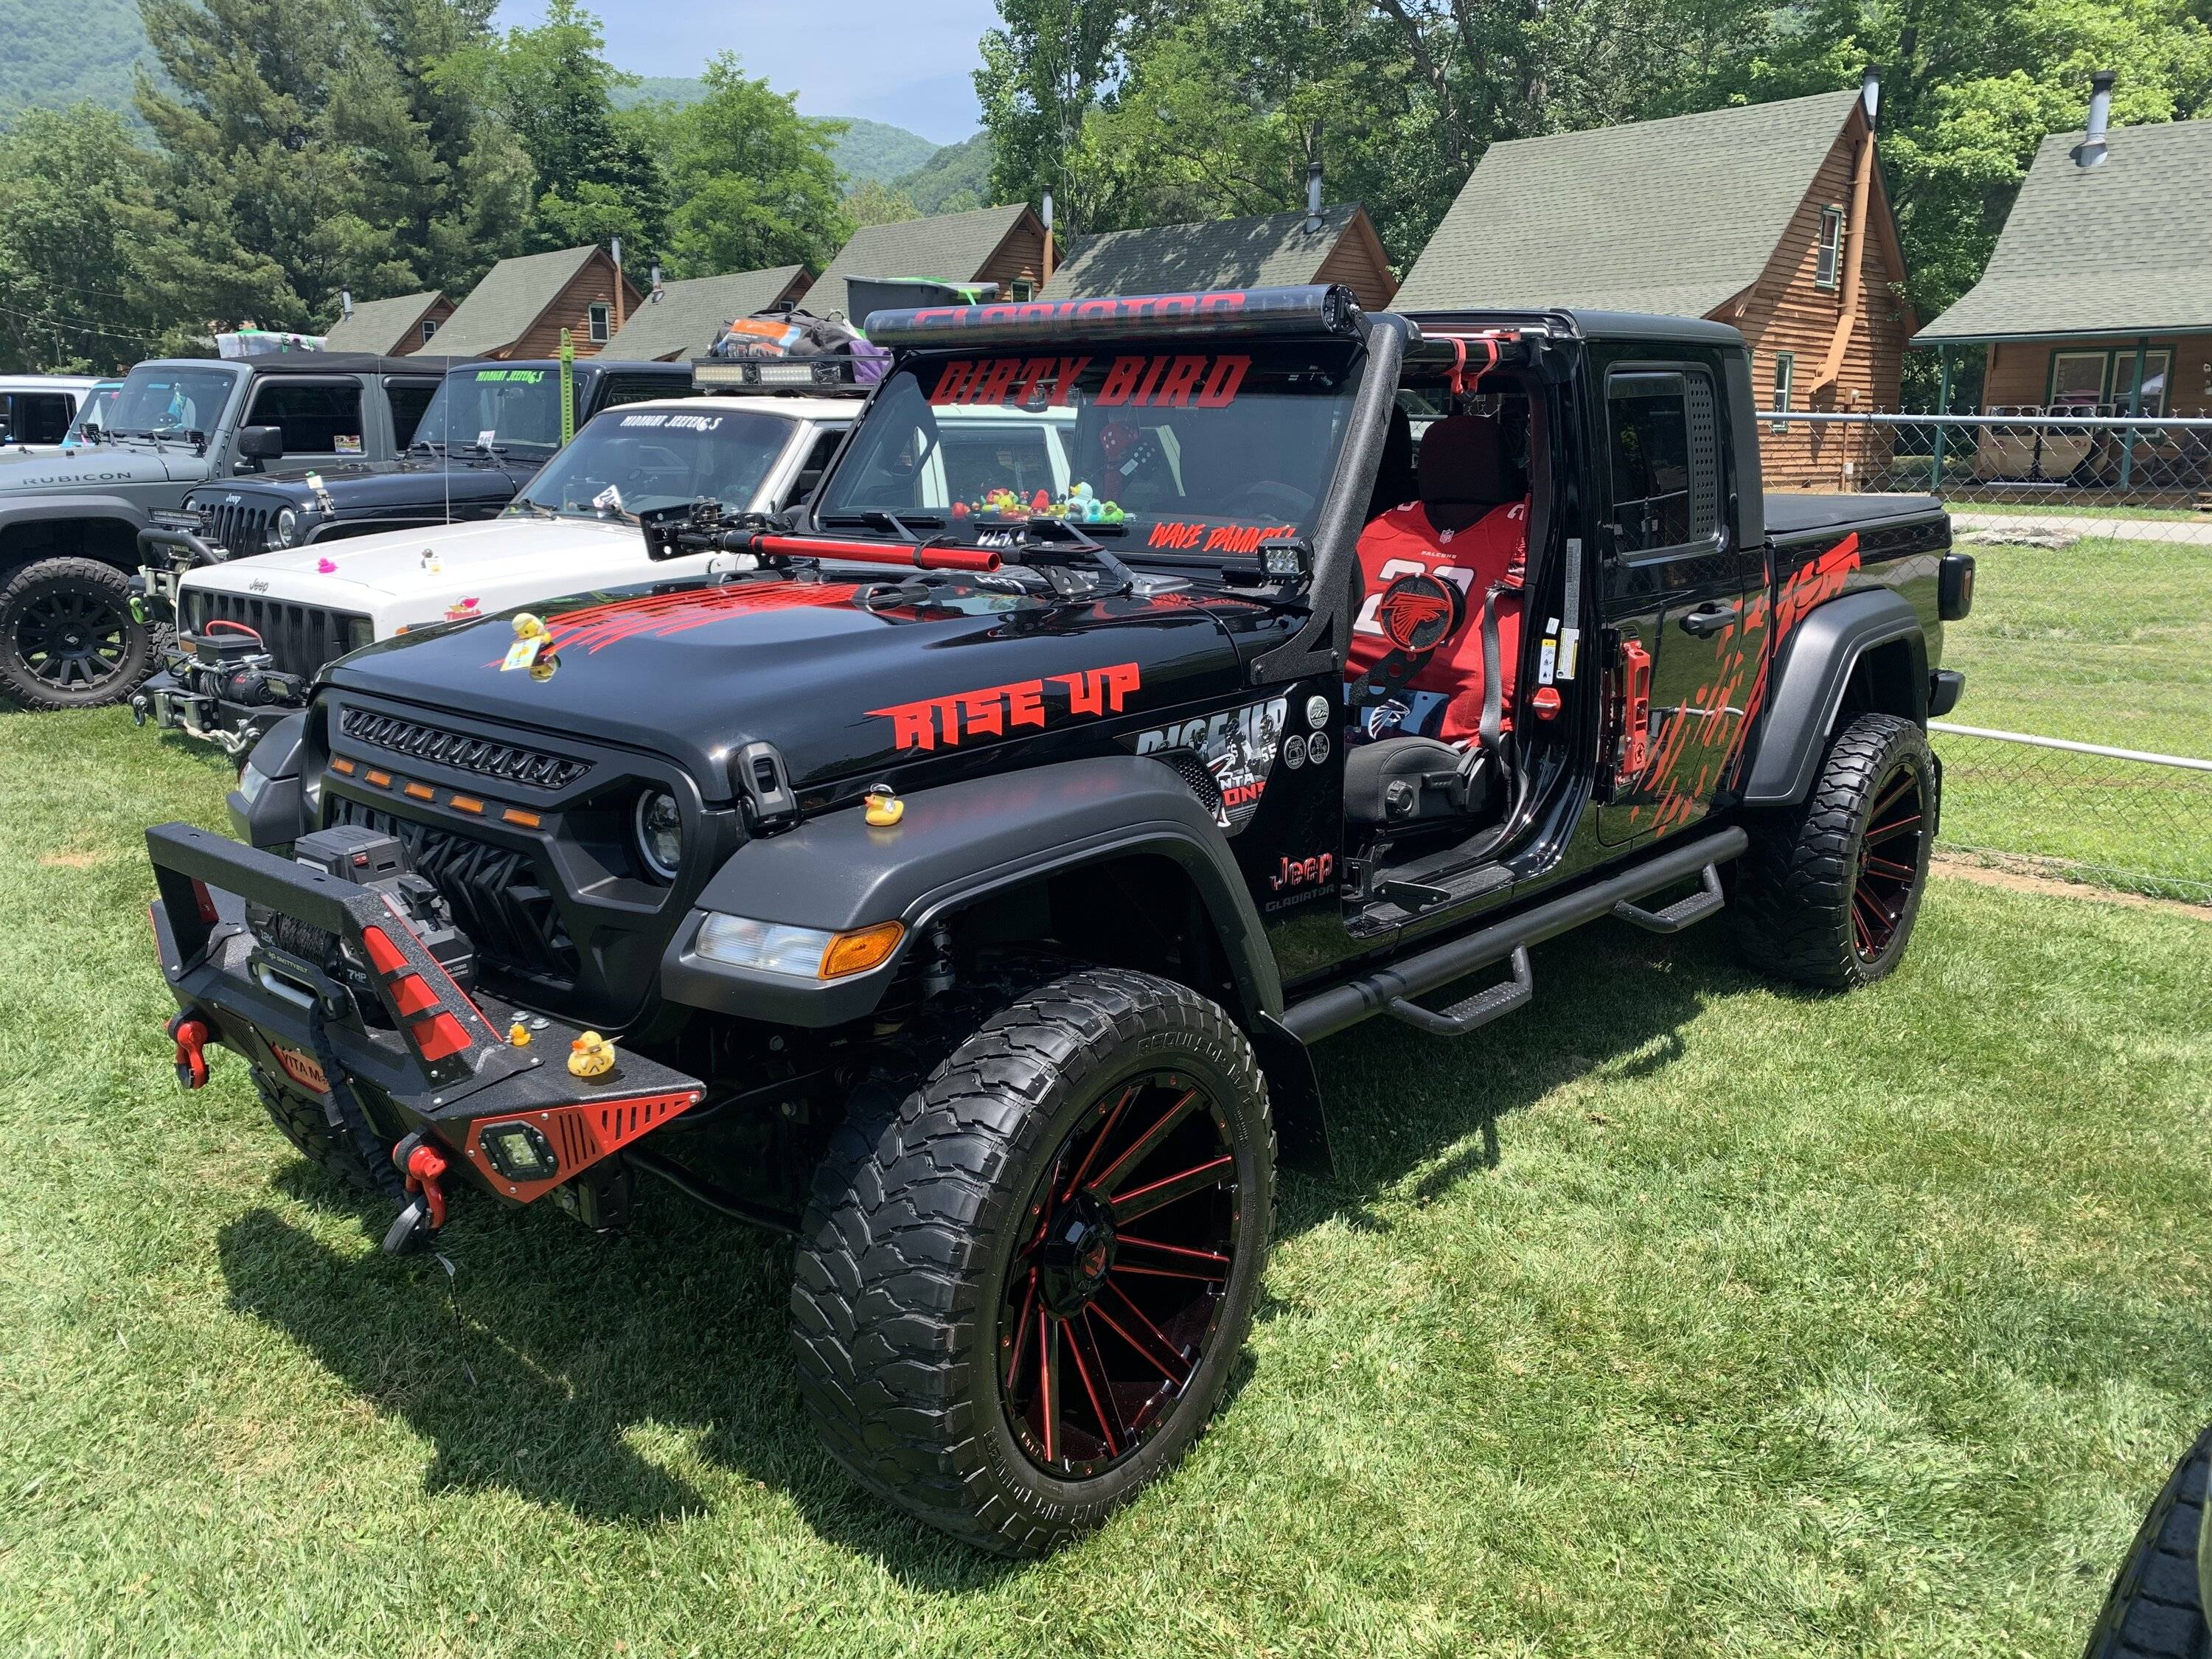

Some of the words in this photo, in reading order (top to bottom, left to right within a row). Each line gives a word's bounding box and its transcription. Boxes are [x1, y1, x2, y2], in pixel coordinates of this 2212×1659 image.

[927, 357, 1096, 407] DIRTY
[1093, 355, 1253, 408] BIRD
[619, 414, 669, 427] MIDNIGHT
[23, 472, 132, 485] RUBICON
[226, 493, 242, 505] Jeep
[1147, 522, 1207, 549] WAVE
[1420, 550, 1458, 559] FALCONS
[249, 578, 269, 594] Jeep
[863, 678, 1046, 751] RISE
[1043, 662, 1141, 717] UP
[1262, 742, 1277, 762] 55
[1269, 853, 1333, 891] Jeep
[1265, 884, 1335, 912] GLADIATOR
[347, 969, 367, 981] 7HP
